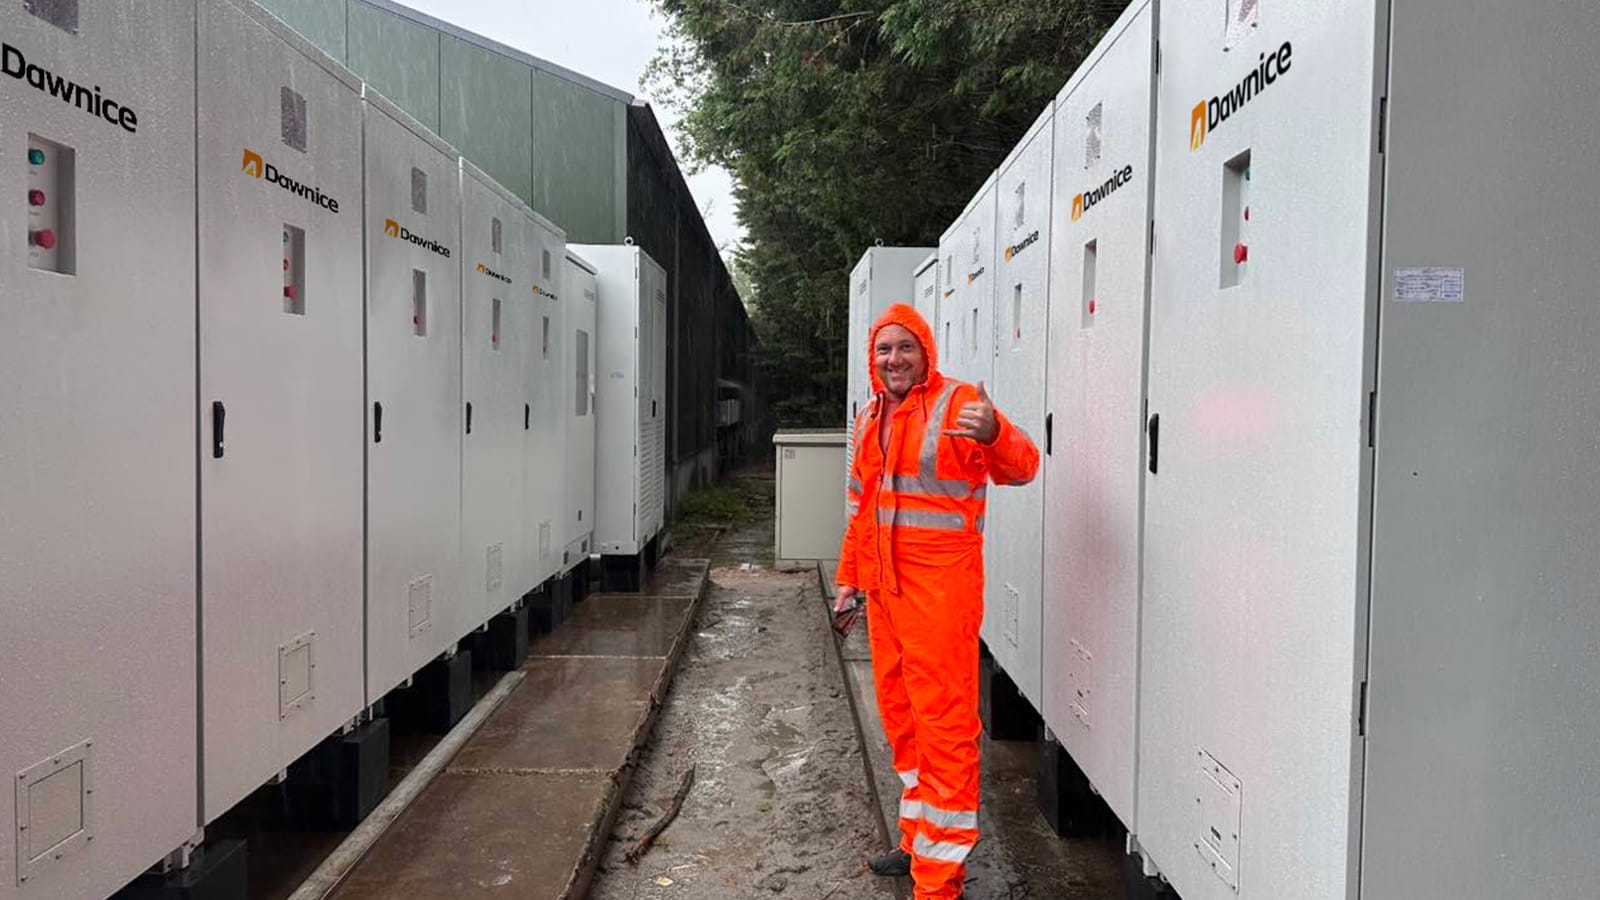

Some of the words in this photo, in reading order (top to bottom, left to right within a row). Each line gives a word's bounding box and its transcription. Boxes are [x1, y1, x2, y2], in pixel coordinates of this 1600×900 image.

[1, 42, 137, 133] Dawnice
[1208, 40, 1292, 133] Dawnice
[265, 162, 339, 214] Dawnice
[1083, 164, 1133, 212] Dawnice
[400, 227, 450, 258] Dawnice
[1011, 230, 1039, 257] Dawnice
